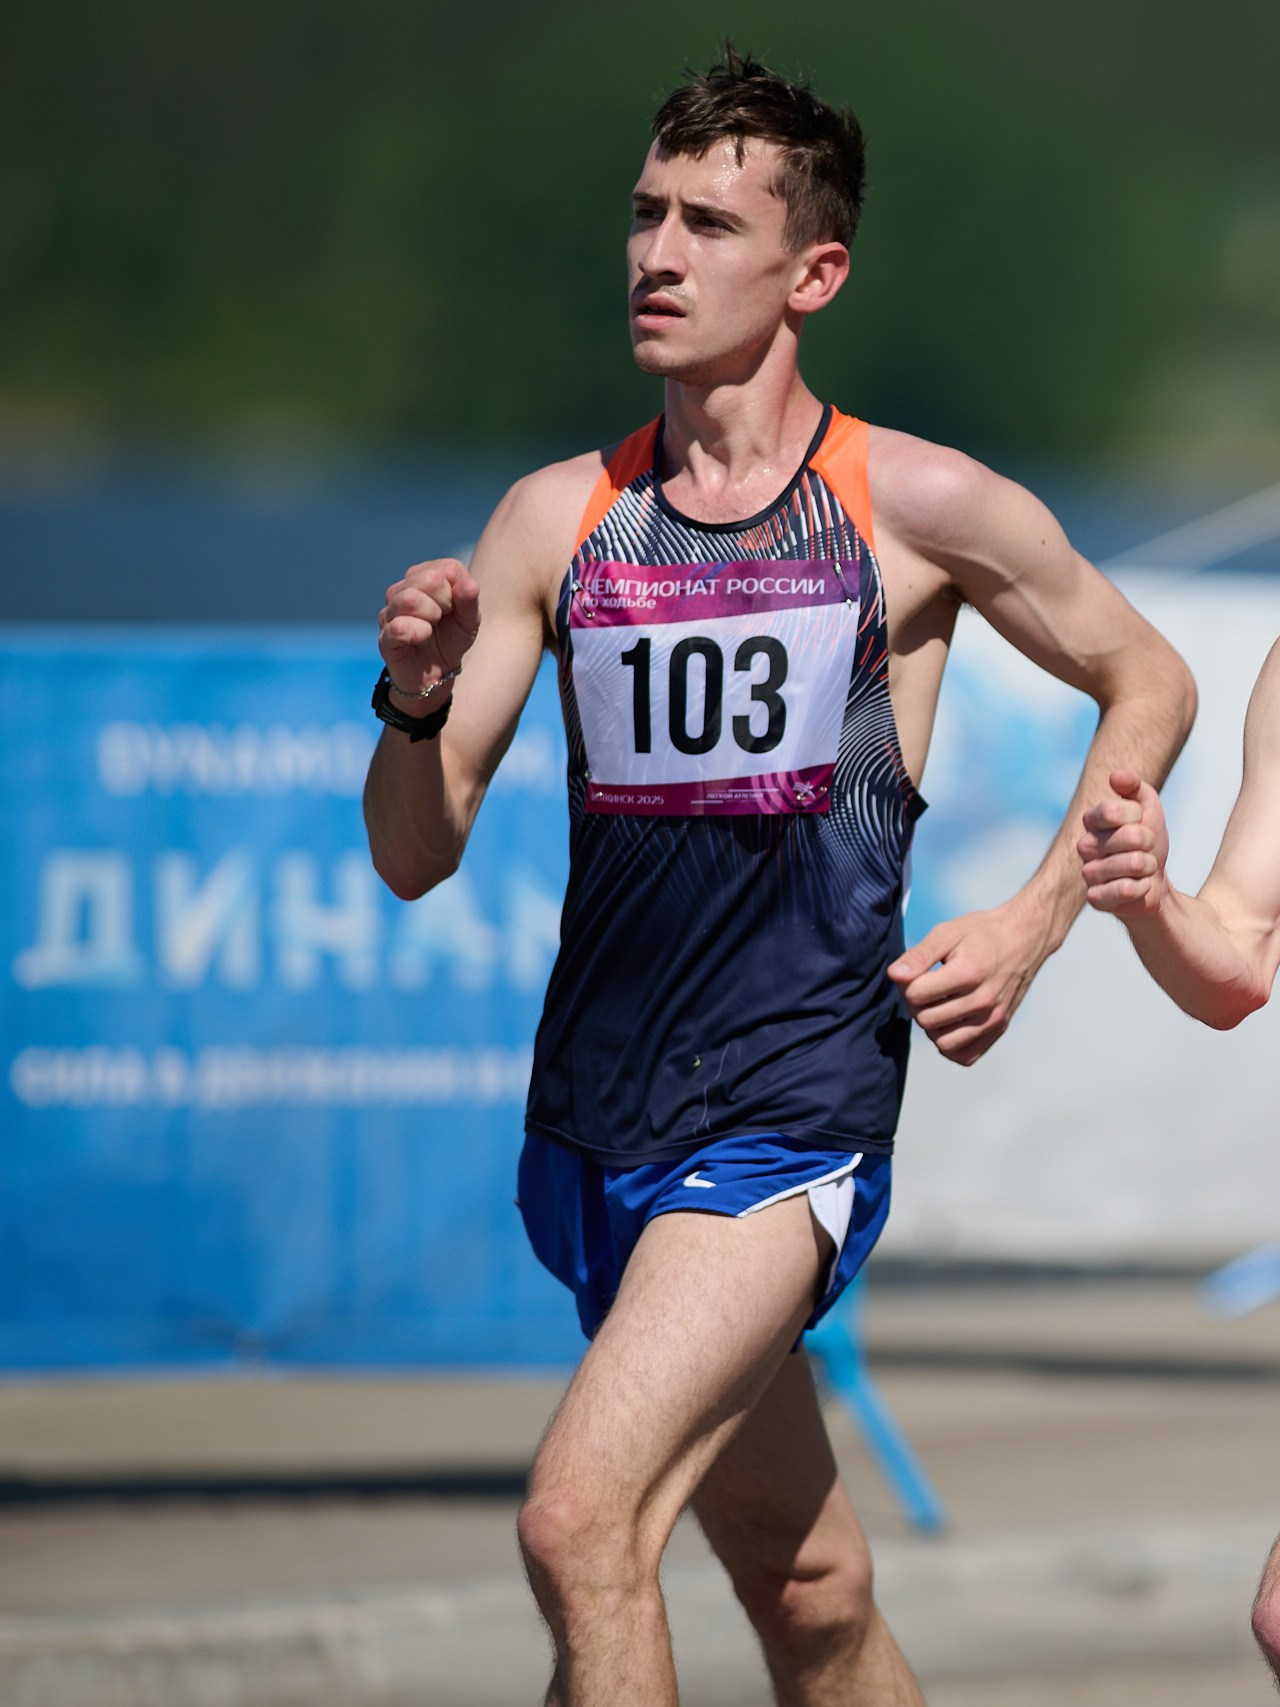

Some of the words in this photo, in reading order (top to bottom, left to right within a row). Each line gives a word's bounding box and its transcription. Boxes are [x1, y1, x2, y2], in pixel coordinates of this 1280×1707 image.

[584, 577, 720, 598] ЧЕМПИОНАТ
[727, 577, 825, 595] РОССИИ
[602, 596, 657, 610] ходьбе
[621, 635, 788, 755] 103
[637, 794, 665, 805] 2025
